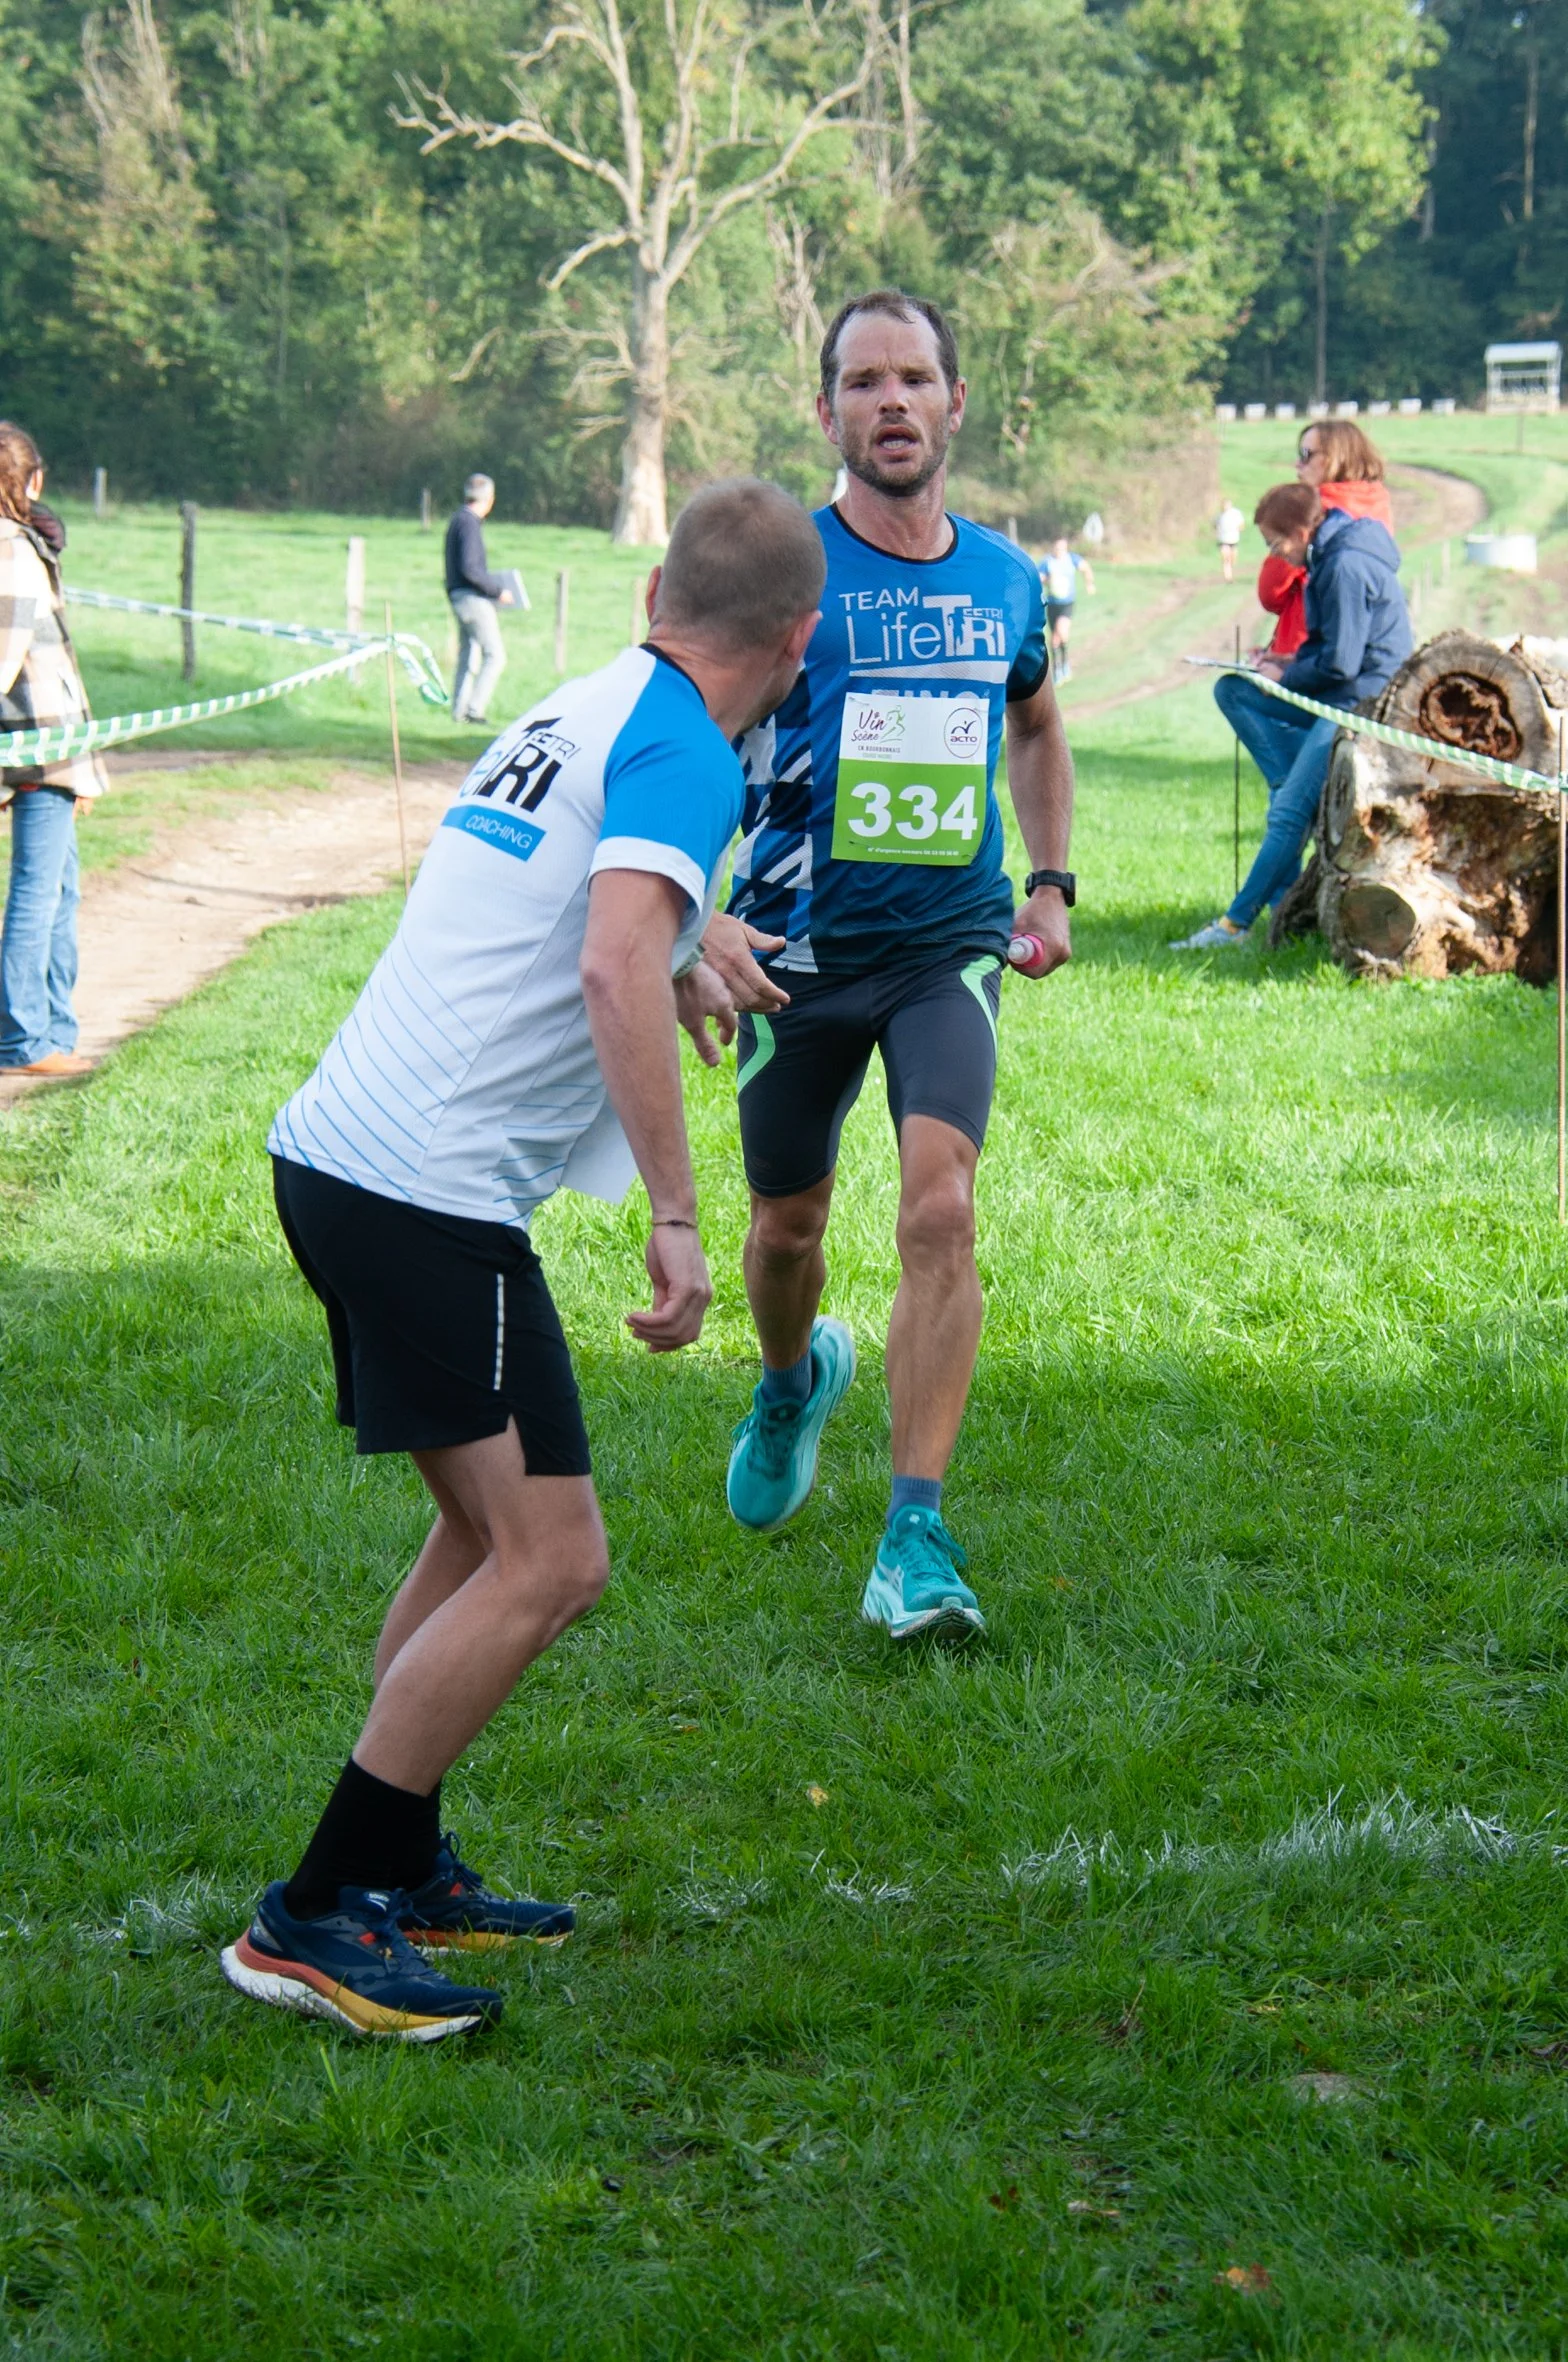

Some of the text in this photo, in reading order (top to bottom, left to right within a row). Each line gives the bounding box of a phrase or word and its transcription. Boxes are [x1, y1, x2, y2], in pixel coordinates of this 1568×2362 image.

[838, 586, 919, 611] TEAM
[848, 782, 978, 841] 334
[466, 814, 533, 849] COACHING
